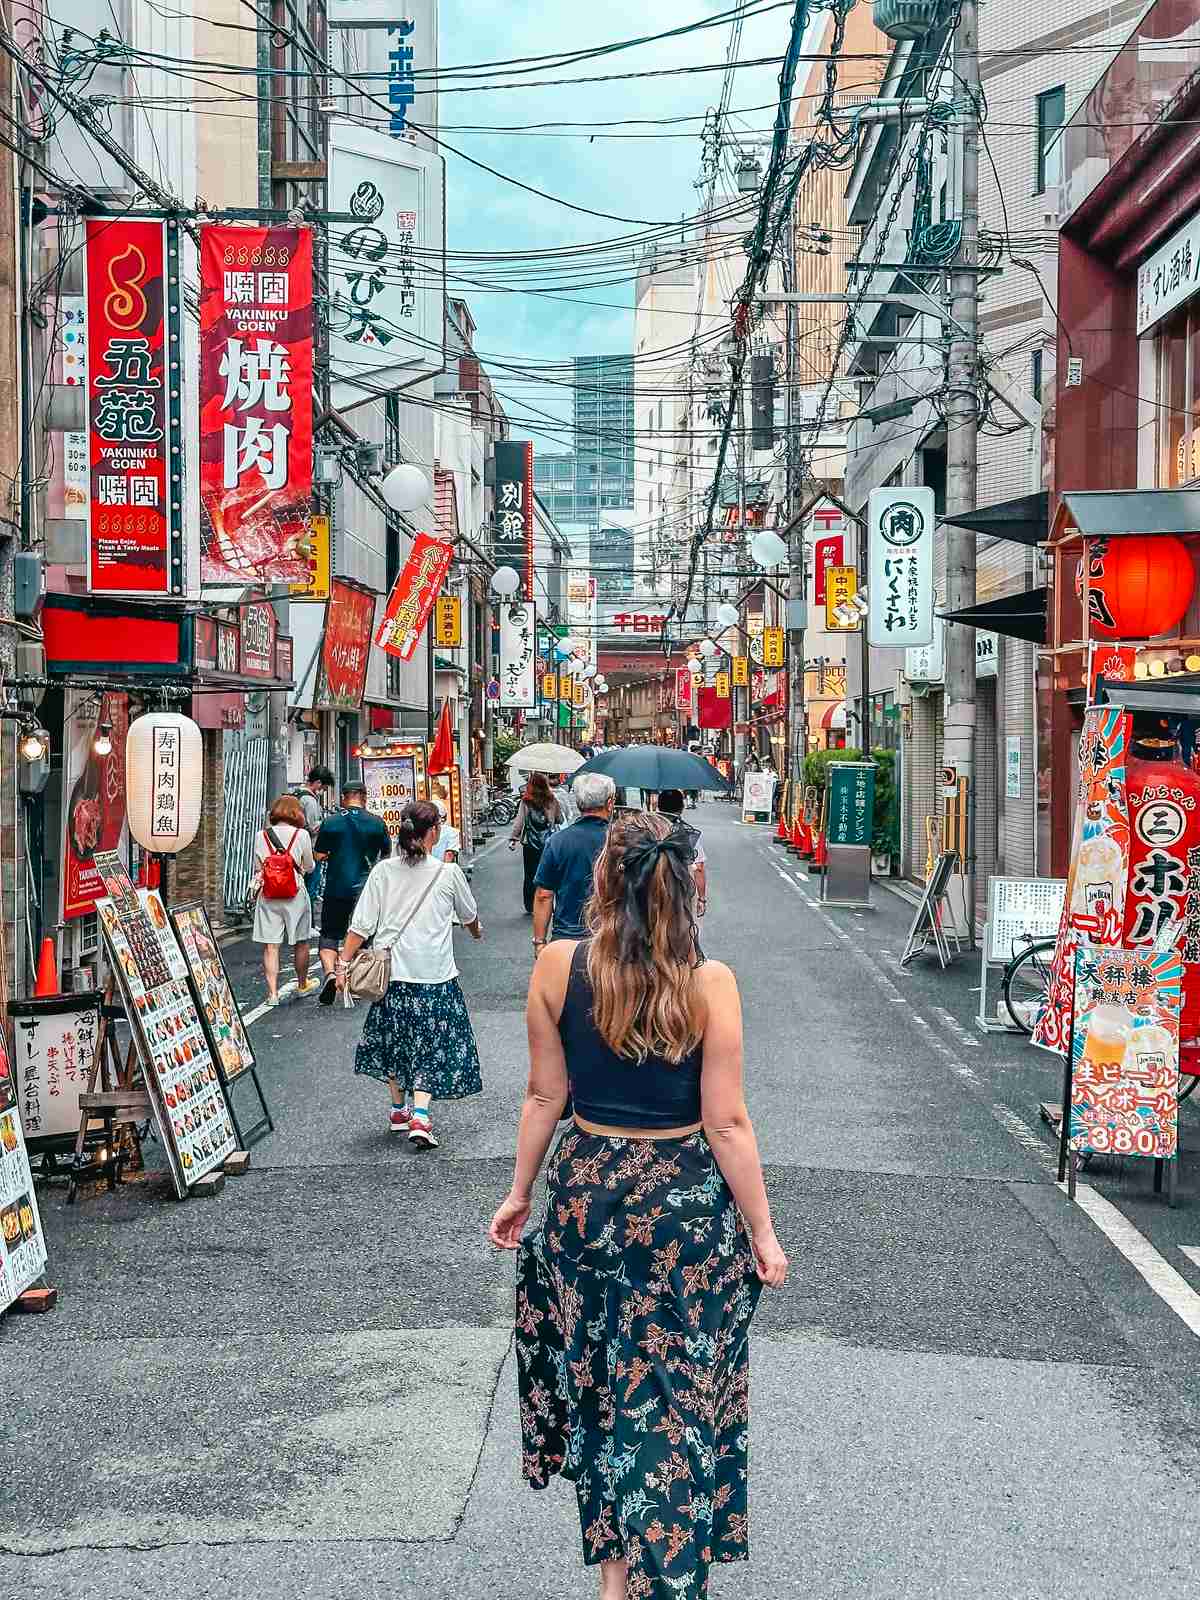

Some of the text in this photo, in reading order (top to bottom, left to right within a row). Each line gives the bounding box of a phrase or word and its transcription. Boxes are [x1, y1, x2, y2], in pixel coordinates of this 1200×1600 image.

[225, 309, 288, 320] YAKINIKU
[238, 321, 275, 331] GOEN
[94, 338, 163, 442] 五苑
[219, 337, 293, 490] 焼肉
[100, 448, 157, 458] YAKINIKU
[111, 459, 146, 469] GOEN
[500, 481, 526, 540] 別館
[890, 510, 915, 537] 肉
[157, 731, 176, 832] 寿司肉鶏魚
[1128, 785, 1196, 810] さんちゃん
[1080, 962, 1155, 988] 天秤棒
[1074, 1060, 1176, 1088] 生ビール
[1072, 1085, 1176, 1112] ハイボール
